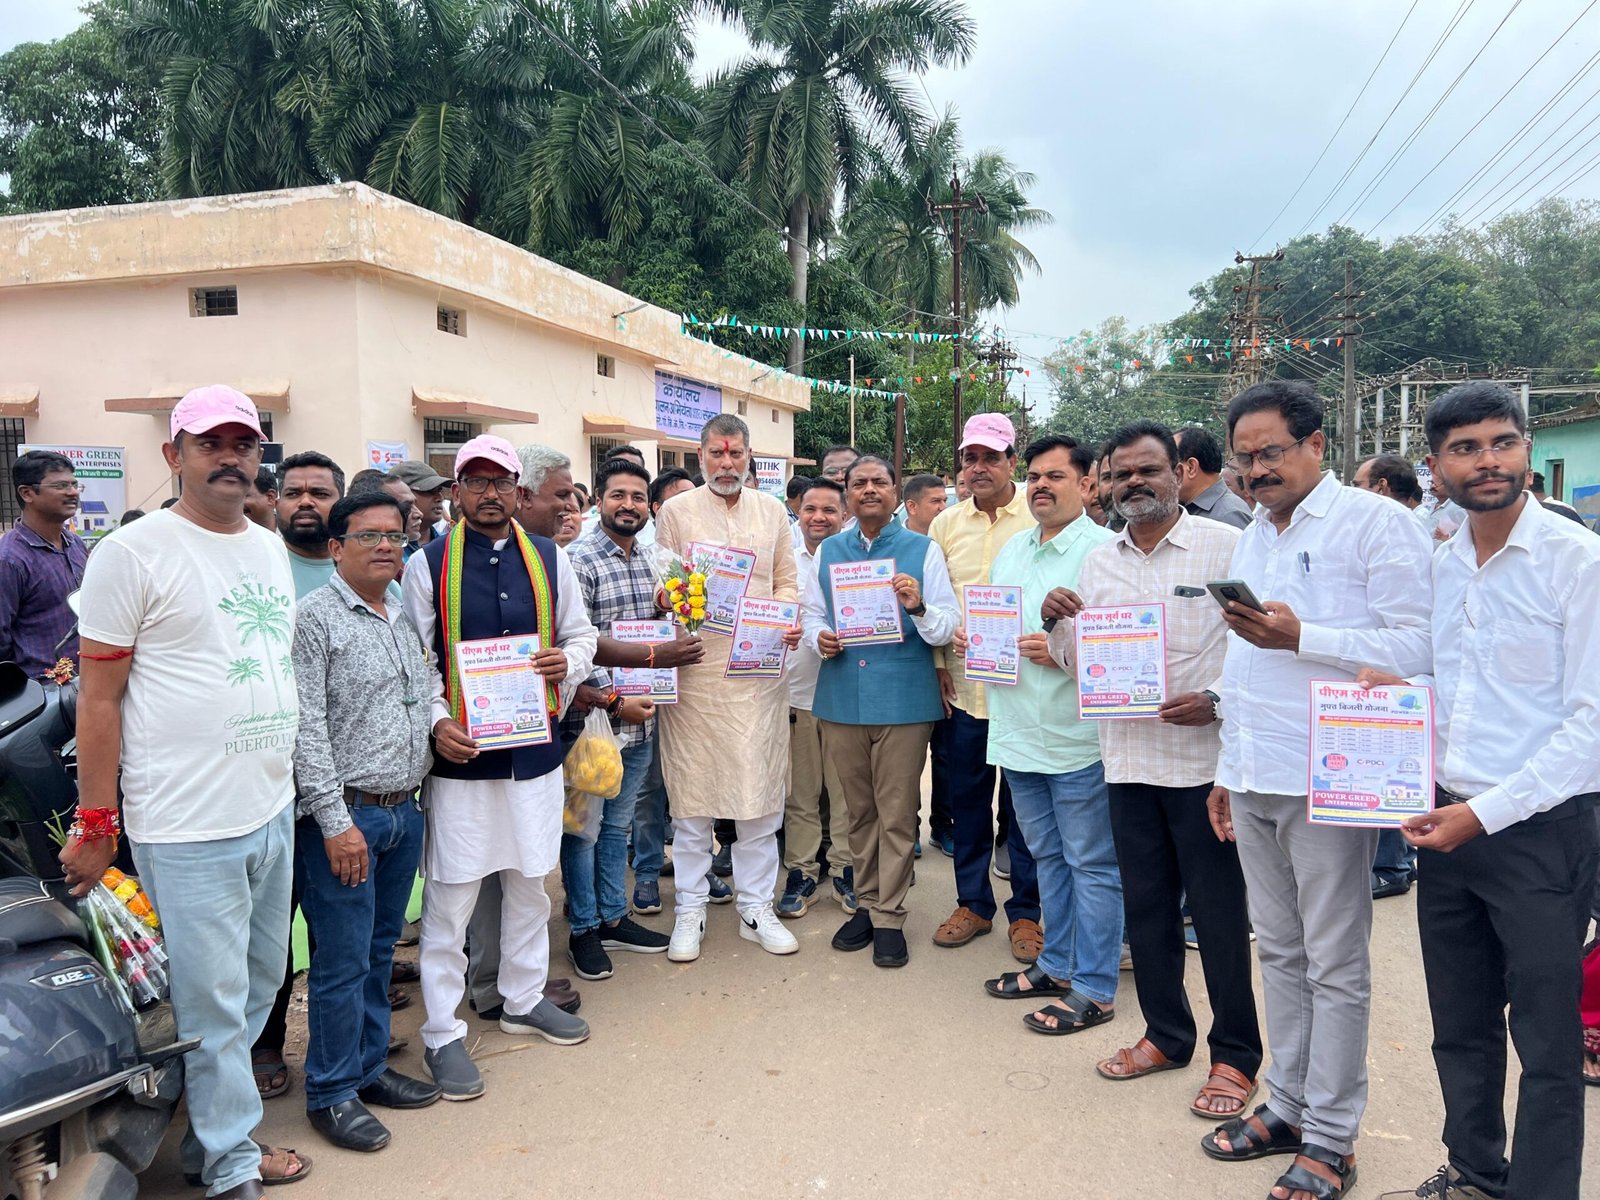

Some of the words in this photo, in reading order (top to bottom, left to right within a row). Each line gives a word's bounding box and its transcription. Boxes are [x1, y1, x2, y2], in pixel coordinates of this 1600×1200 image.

[663, 383, 700, 403] कार्यालय
[86, 450, 121, 460] GREEN
[756, 462, 780, 470] OTHK
[218, 583, 290, 613] MEXICO
[1081, 612, 1102, 622] पीएम
[1105, 611, 1118, 622] सूर्य
[1121, 612, 1132, 620] घर
[462, 646, 482, 656] पीएम
[484, 644, 498, 656] सूर्य
[500, 644, 510, 652] घर
[1319, 686, 1348, 698] पीएम
[1373, 691, 1388, 699] घर
[1364, 703, 1388, 712] योजना
[225, 734, 279, 756] PUERTO
[1315, 792, 1348, 800] POWER
[1348, 794, 1378, 802] GREEN
[1324, 800, 1368, 808] ENTERPRISES
